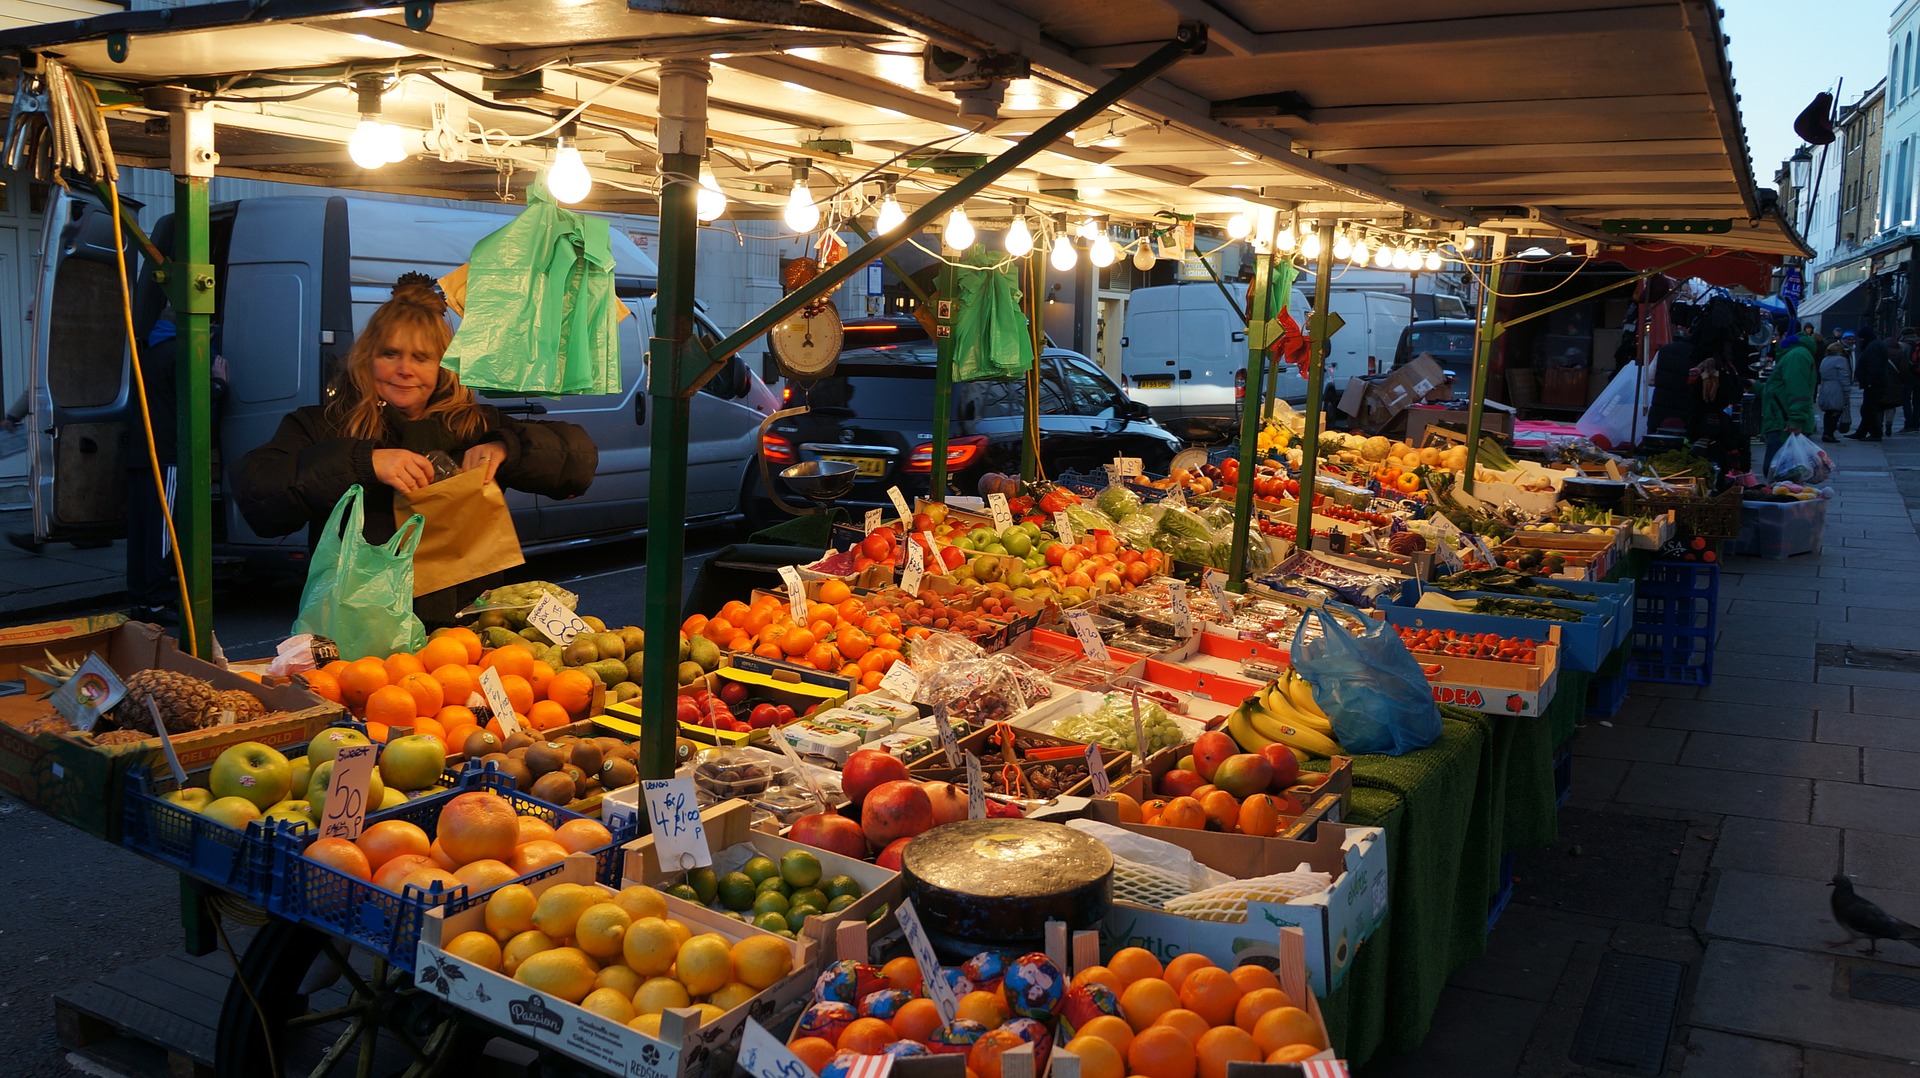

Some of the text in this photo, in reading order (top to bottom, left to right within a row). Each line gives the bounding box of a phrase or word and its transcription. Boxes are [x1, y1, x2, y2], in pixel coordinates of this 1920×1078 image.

[3, 734, 37, 757] GOLD
[262, 732, 292, 746] GOLD
[338, 746, 370, 762] Sweet
[328, 768, 361, 819] 50
[652, 800, 669, 837] 4
[511, 1003, 561, 1032] Passion
